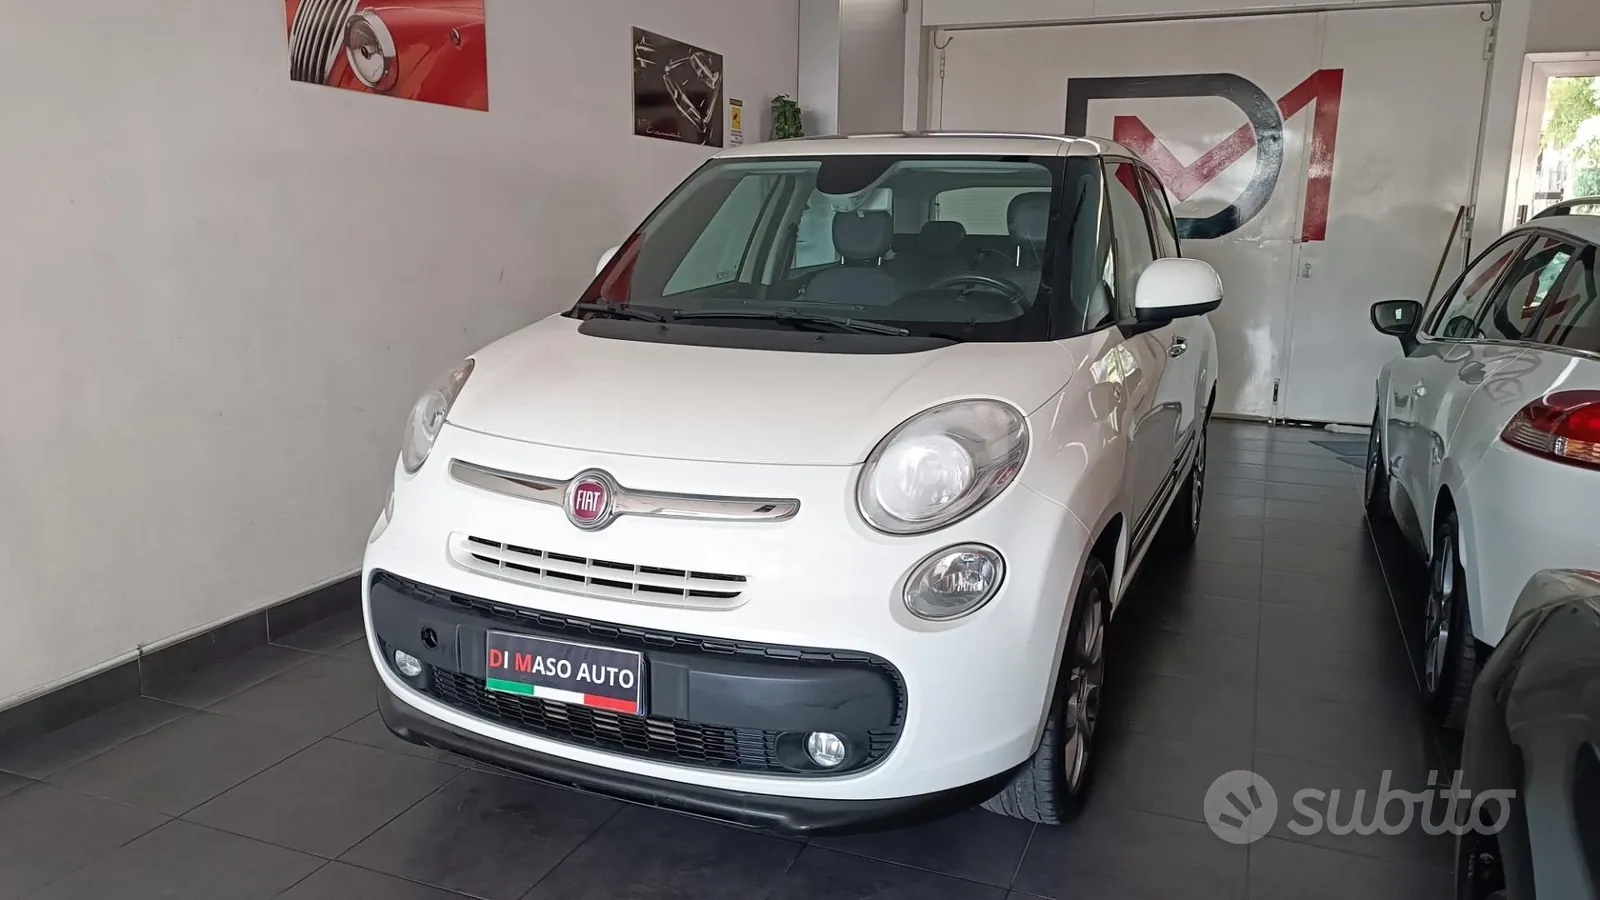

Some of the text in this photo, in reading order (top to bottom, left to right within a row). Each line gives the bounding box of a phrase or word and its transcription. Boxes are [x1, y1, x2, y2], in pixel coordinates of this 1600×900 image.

[576, 490, 601, 512] FIAT
[489, 648, 634, 689] DI MASO AUTO
